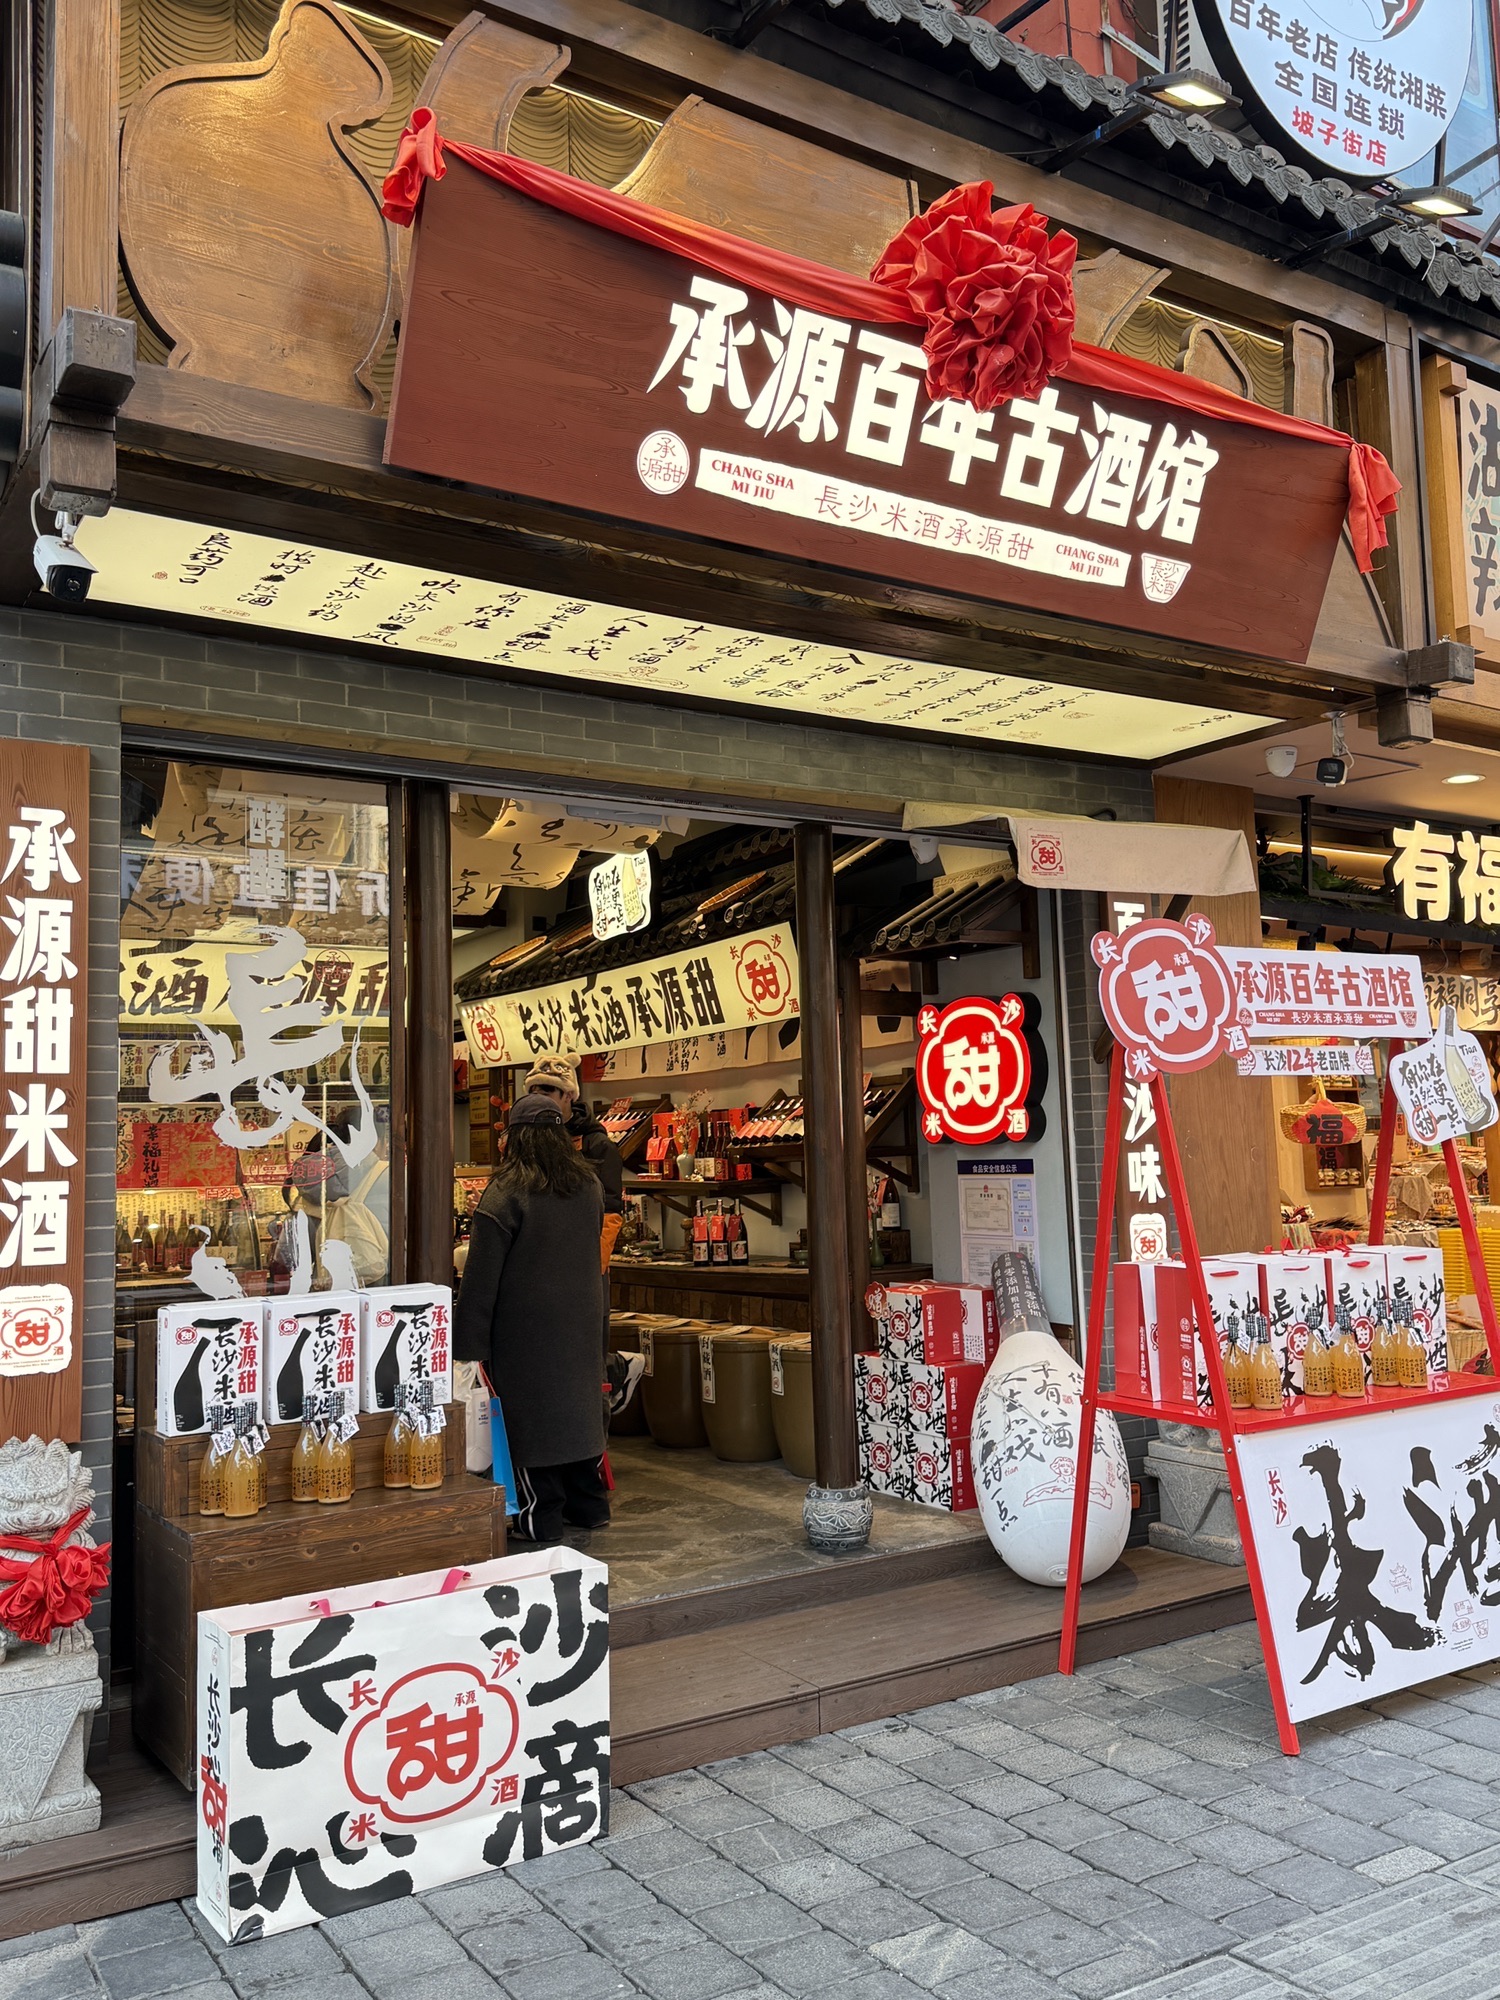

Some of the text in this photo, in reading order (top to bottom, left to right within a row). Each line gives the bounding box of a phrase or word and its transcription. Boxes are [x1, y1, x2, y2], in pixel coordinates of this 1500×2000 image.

[1229, 0, 1448, 120] 百年老店 传统湘菜
[1274, 59, 1406, 141] 全国连锁
[1291, 105, 1388, 167] 坡子街店
[646, 275, 1220, 545] 承源百年古酒馆
[711, 458, 795, 491] CHANG SHA
[731, 480, 776, 502] MI JIU
[814, 485, 1035, 561] 長沙米酒承源甜
[1055, 543, 1121, 569] CHANG SHA
[1069, 560, 1105, 579] MI JIU
[464, 591, 526, 629] 有你在
[1038, 846, 1056, 865] 甜
[729, 933, 782, 961] 长 沙
[1098, 918, 1211, 964] 长 沙
[746, 958, 780, 1004] 甜
[1130, 960, 1208, 1043] 甜
[1234, 960, 1415, 1008] 承源百年古酒馆
[518, 957, 726, 1055] 长沙米酒承源甜
[746, 1007, 758, 1022] 米
[920, 998, 1021, 1035] 长 沙
[1291, 1011, 1364, 1025] 長沙米酒承源甜
[0, 806, 81, 1268] 承源甜米酒
[475, 1020, 496, 1052] 甜
[1130, 1025, 1249, 1080] 米 酒
[1459, 1043, 1478, 1057] Tian
[943, 1036, 1001, 1112] 甜
[1264, 1047, 1351, 1074] 长沙12年老品牌
[1398, 1052, 1445, 1090] 有你在
[925, 1108, 1027, 1137] 米 酒
[1306, 1114, 1344, 1145] 福
[972, 1164, 1018, 1174] 食品安全信息公示
[1140, 1236, 1157, 1254] 甜
[15, 1319, 50, 1348] 甜
[336, 1312, 356, 1384] 承源甜
[430, 1305, 449, 1373] 承源甜
[237, 1321, 259, 1395] 承源甜
[1032, 1362, 1074, 1449] 十有八酒
[1268, 1470, 1289, 1525] 长沙
[230, 1573, 610, 1770] 长 沙
[347, 1647, 521, 1711] 长 沙
[453, 1689, 477, 1707] 承源
[385, 1702, 484, 1801] 甜
[344, 1773, 519, 1845] 米 酒
